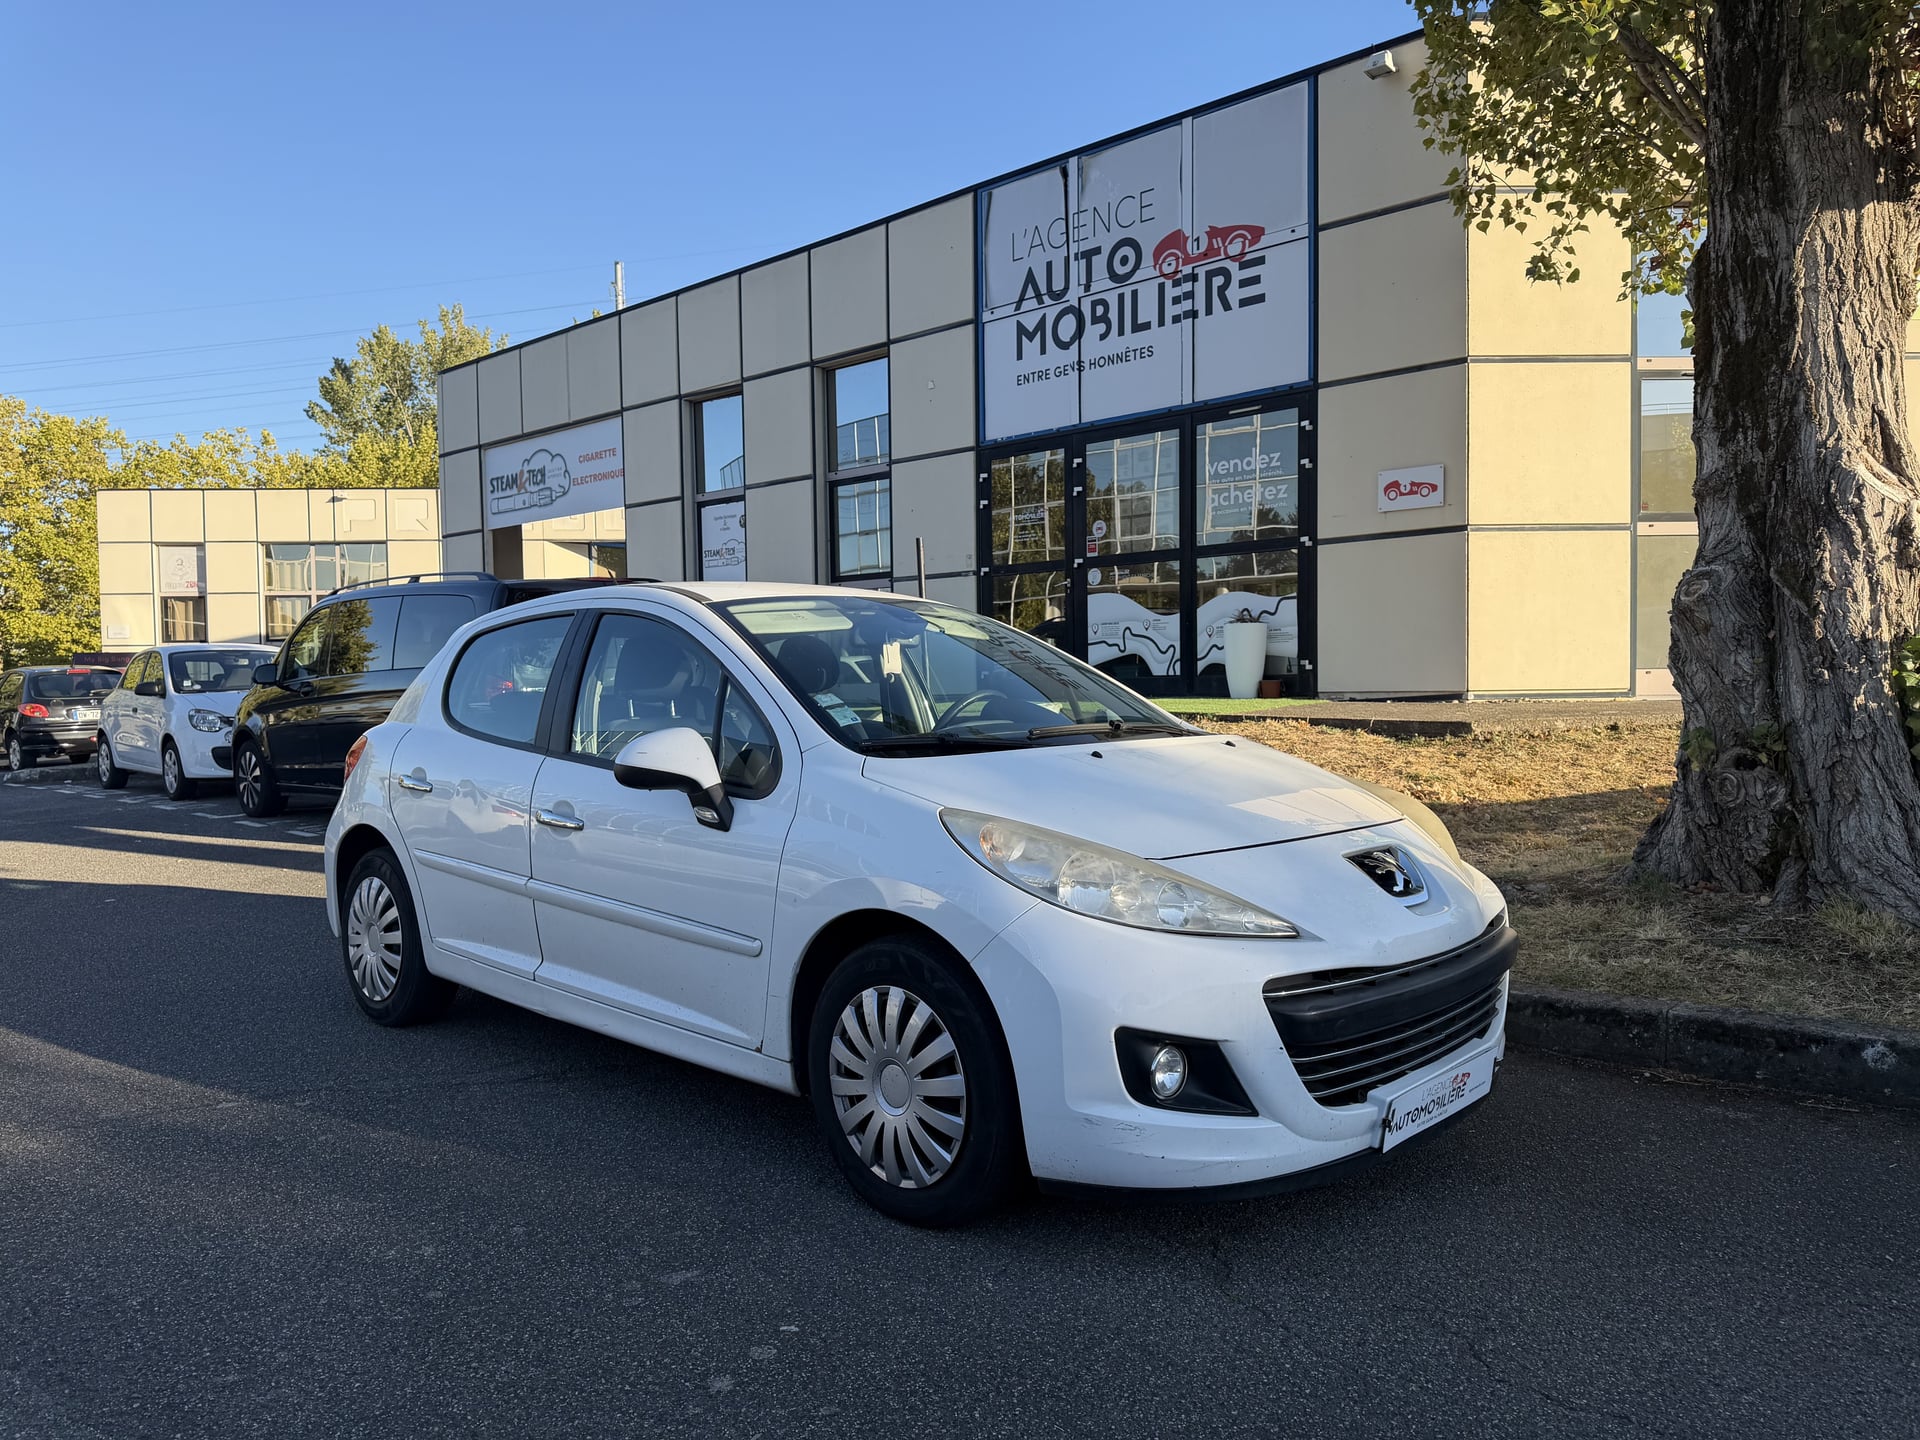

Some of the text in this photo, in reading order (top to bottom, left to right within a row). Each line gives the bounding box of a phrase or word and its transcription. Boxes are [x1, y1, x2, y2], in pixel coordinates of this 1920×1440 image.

[1011, 187, 1156, 263] L'AGENCE
[1013, 236, 1143, 313] AUTO
[1016, 345, 1155, 387] ENTRE GENS HONNÊTES
[578, 447, 617, 464] CIGARETTE
[1208, 447, 1281, 476] vendez
[572, 467, 625, 486] ELECTRONIQUE
